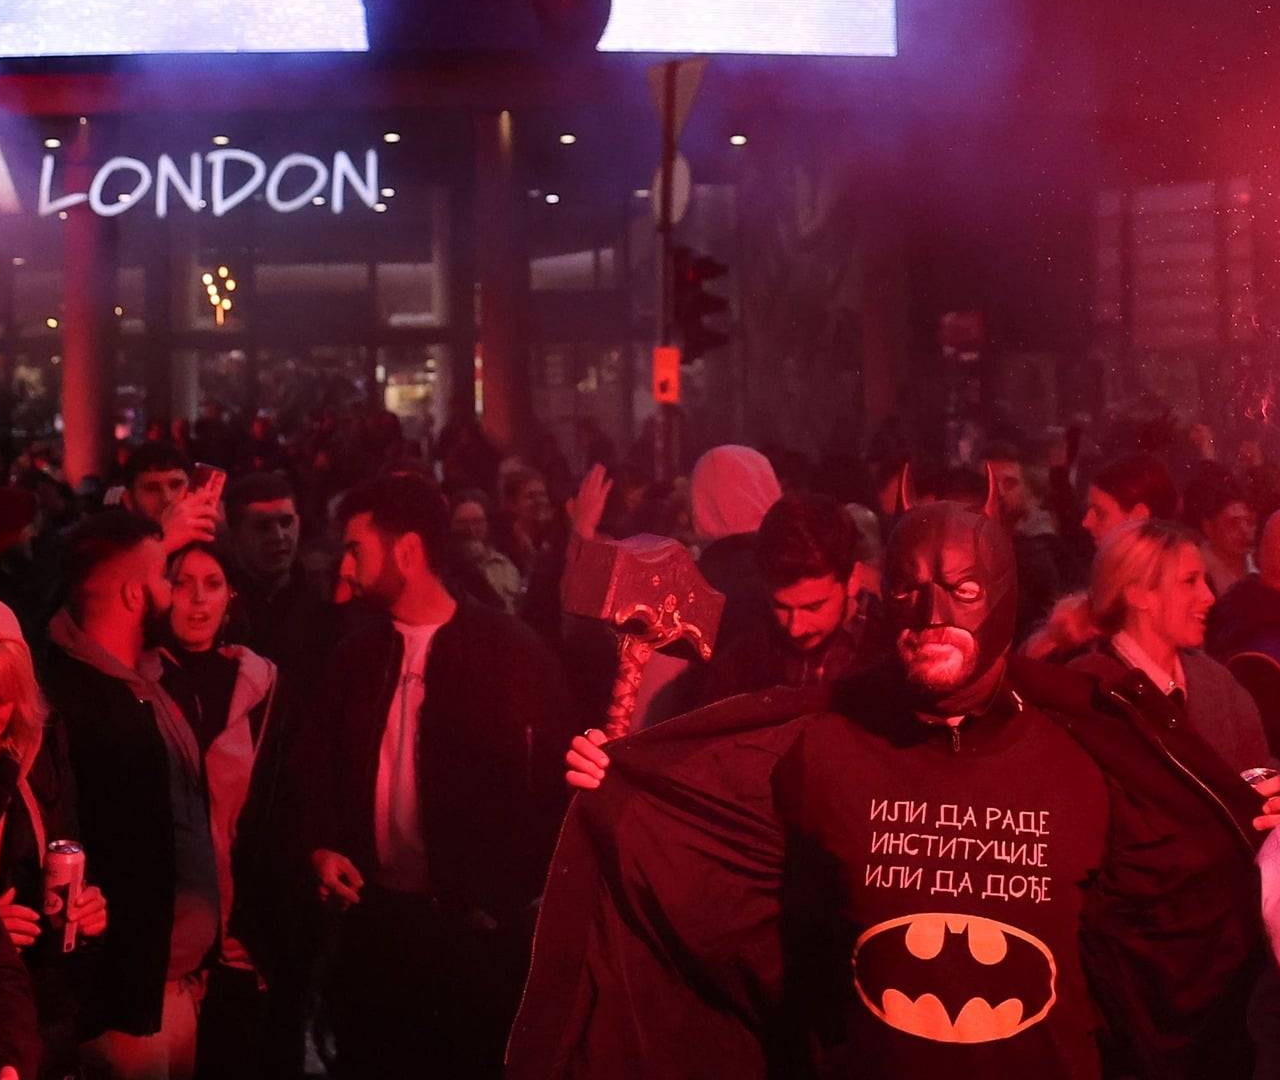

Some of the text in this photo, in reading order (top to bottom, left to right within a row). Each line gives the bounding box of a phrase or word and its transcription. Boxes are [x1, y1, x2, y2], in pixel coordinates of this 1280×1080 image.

[37, 147, 380, 218] LONDON
[870, 798, 1050, 837] ИЛИ ДА РАДЕ
[870, 831, 1049, 868] ИНСТИТУЦИЈЕ
[864, 864, 1052, 903] ИЛИ ДА ДОЂЕ
